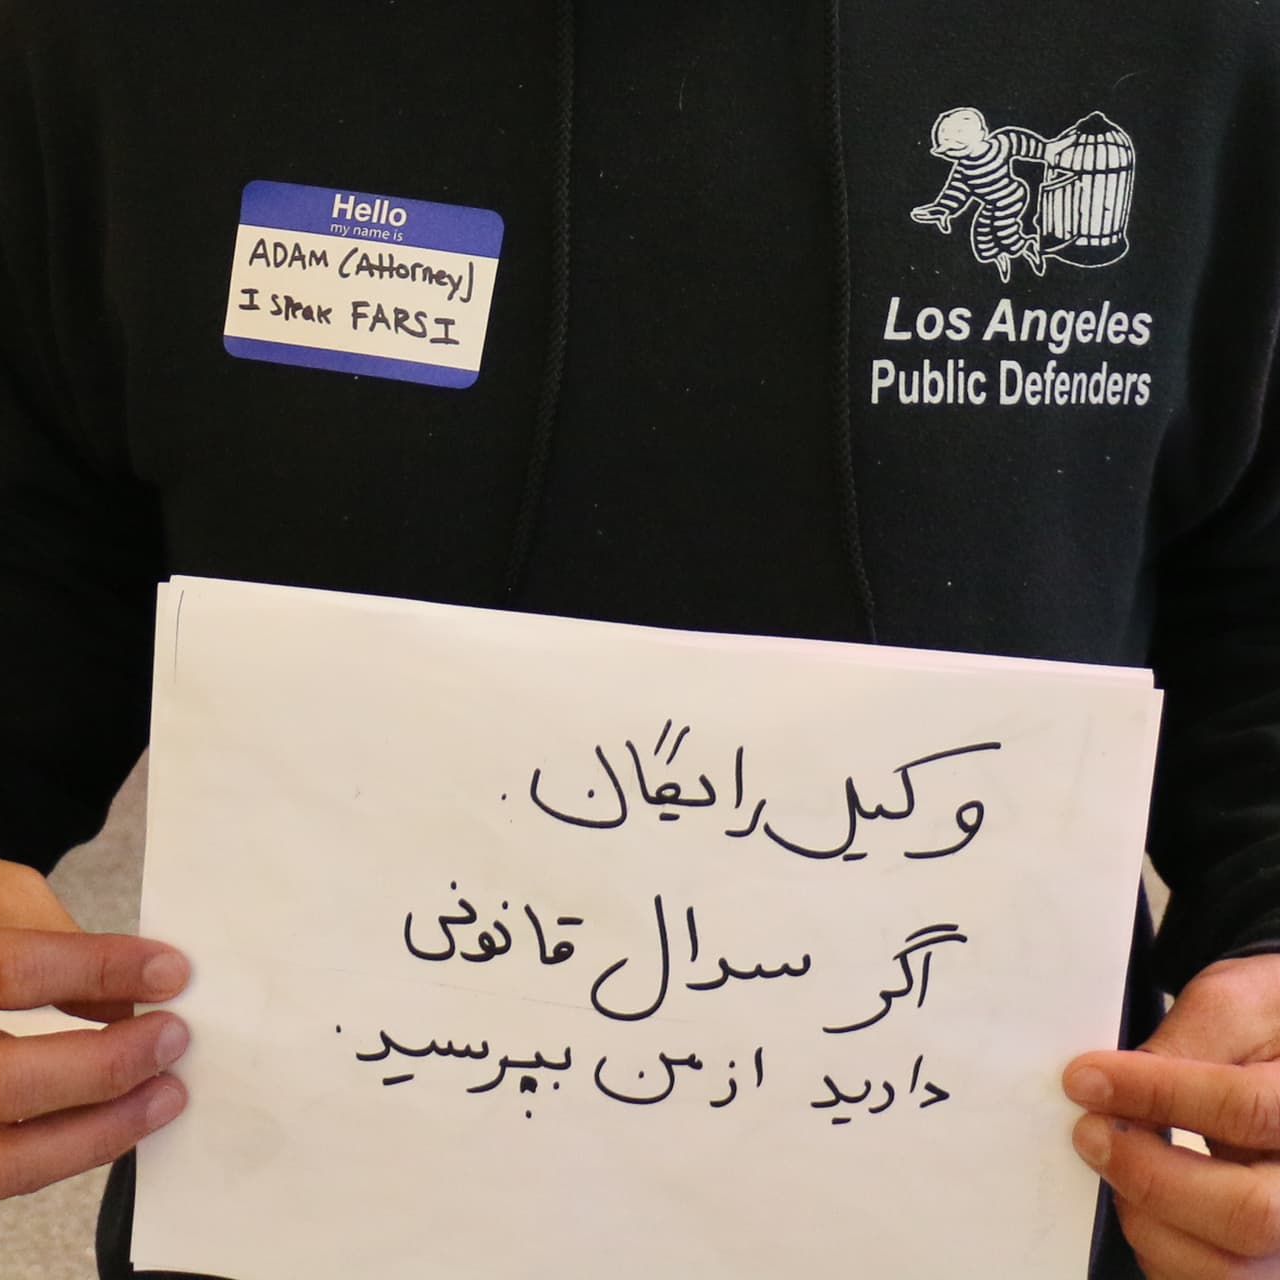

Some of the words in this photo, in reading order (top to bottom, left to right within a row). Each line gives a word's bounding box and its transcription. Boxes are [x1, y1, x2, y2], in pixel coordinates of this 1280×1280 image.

[330, 193, 408, 227] Hello
[330, 222, 351, 238] my
[353, 225, 390, 240] name
[393, 228, 404, 241] is
[248, 238, 329, 270] ADAM
[238, 288, 261, 311] I
[351, 301, 460, 345] FARSI
[883, 296, 973, 341] Los
[982, 298, 1153, 354] Angeles
[871, 358, 987, 405] Public
[999, 359, 1152, 406] Defenders
